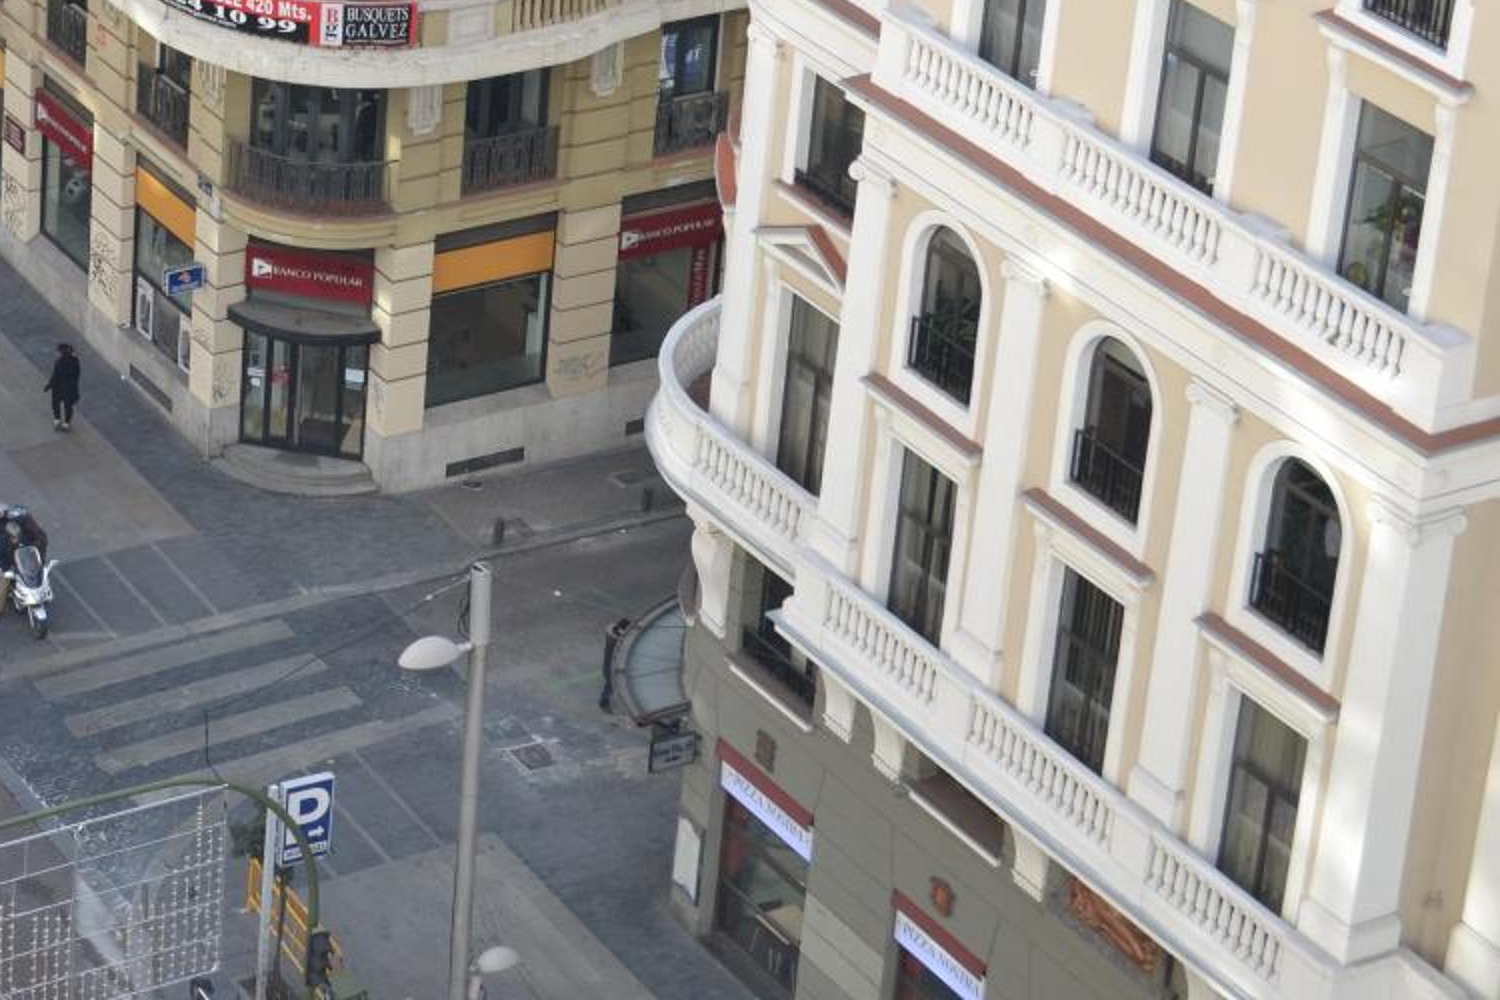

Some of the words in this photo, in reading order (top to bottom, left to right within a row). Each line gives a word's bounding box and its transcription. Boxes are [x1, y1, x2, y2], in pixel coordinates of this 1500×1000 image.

[214, 5, 247, 25] 10
[257, 17, 297, 33] 99
[278, 1, 312, 20] Mts.
[347, 7, 409, 24] BUSQUETS
[346, 23, 408, 39] GALVEZ
[273, 266, 311, 280] BANCO
[313, 272, 363, 288] POPULAR
[285, 787, 331, 846] P
[902, 921, 936, 961] PIZZA
